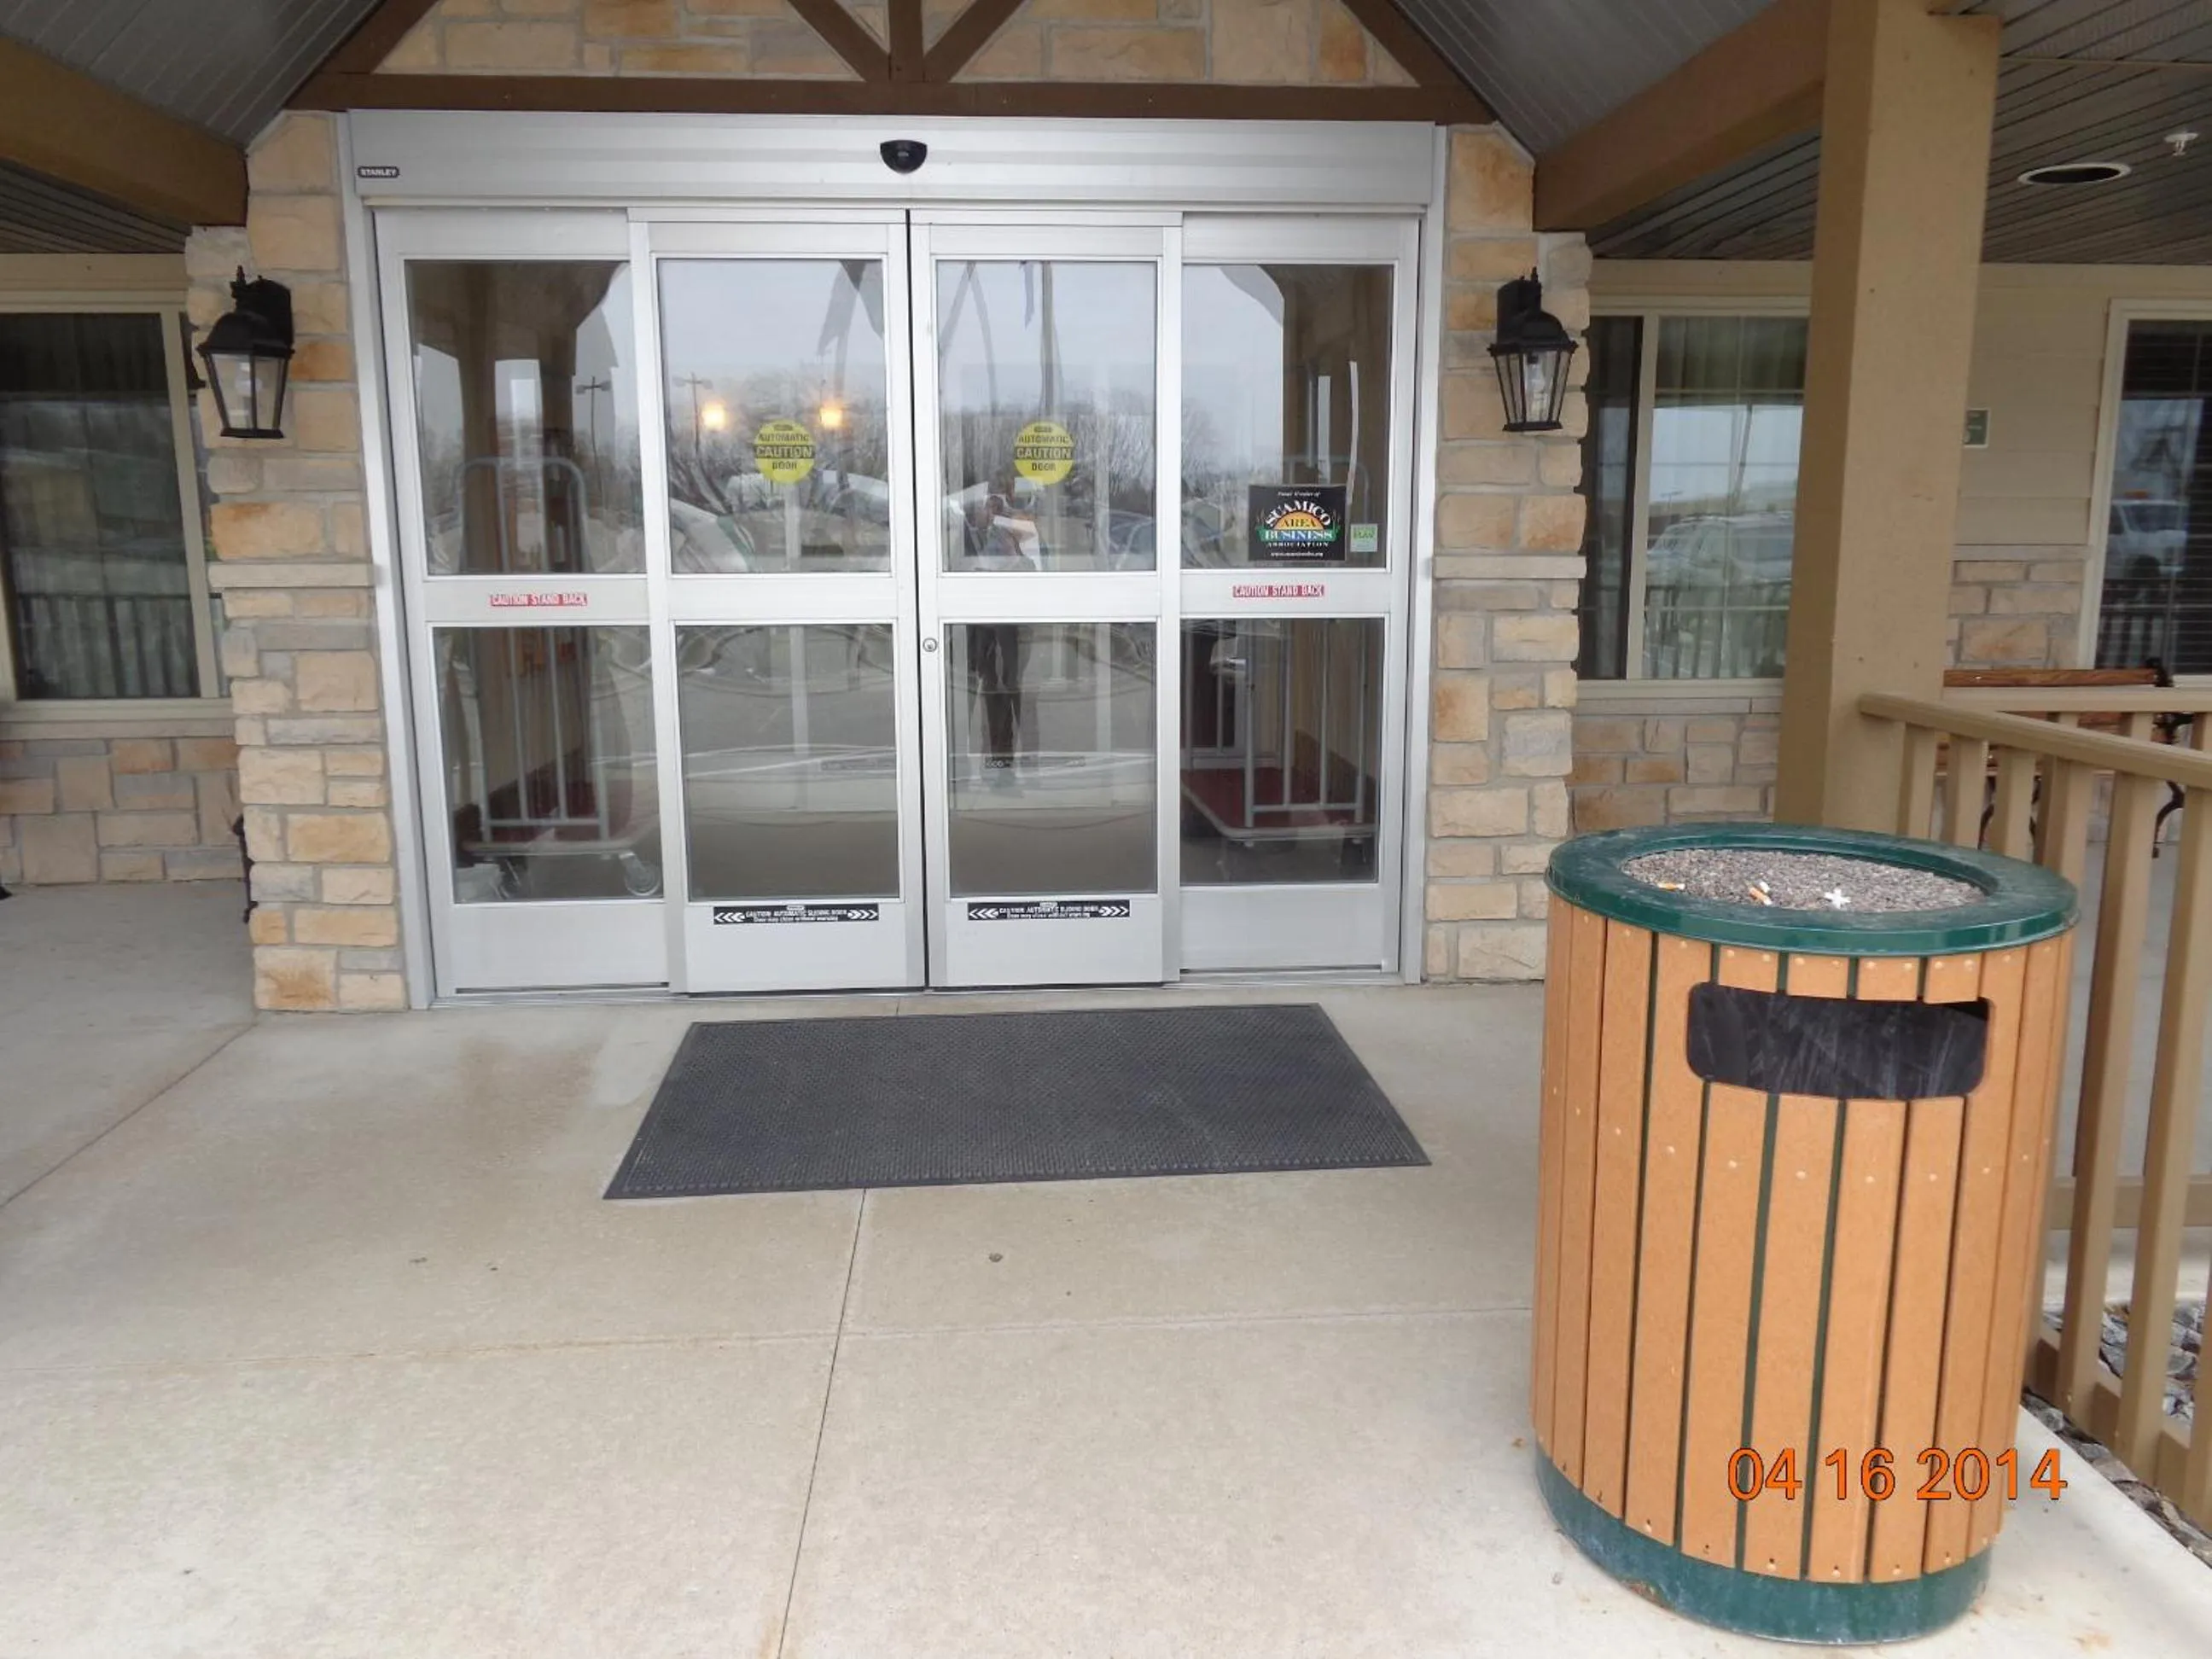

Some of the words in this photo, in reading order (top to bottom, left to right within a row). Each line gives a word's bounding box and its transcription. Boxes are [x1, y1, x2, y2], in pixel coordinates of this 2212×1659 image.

[1019, 434, 1069, 443] AUTOMATIC
[756, 446, 812, 457] CAUTION
[1016, 448, 1072, 458] CAUTION
[1032, 463, 1057, 471] DOOR
[1265, 500, 1331, 527] SUAMICO
[1282, 518, 1316, 527] AREA
[1265, 530, 1333, 539] BUSINESS
[1235, 586, 1268, 596] CAUTION
[1272, 586, 1298, 596] STAND
[1301, 585, 1324, 595] BACK
[492, 595, 527, 605] CAUTION
[531, 595, 558, 605] STAND
[562, 594, 586, 605] BACK
